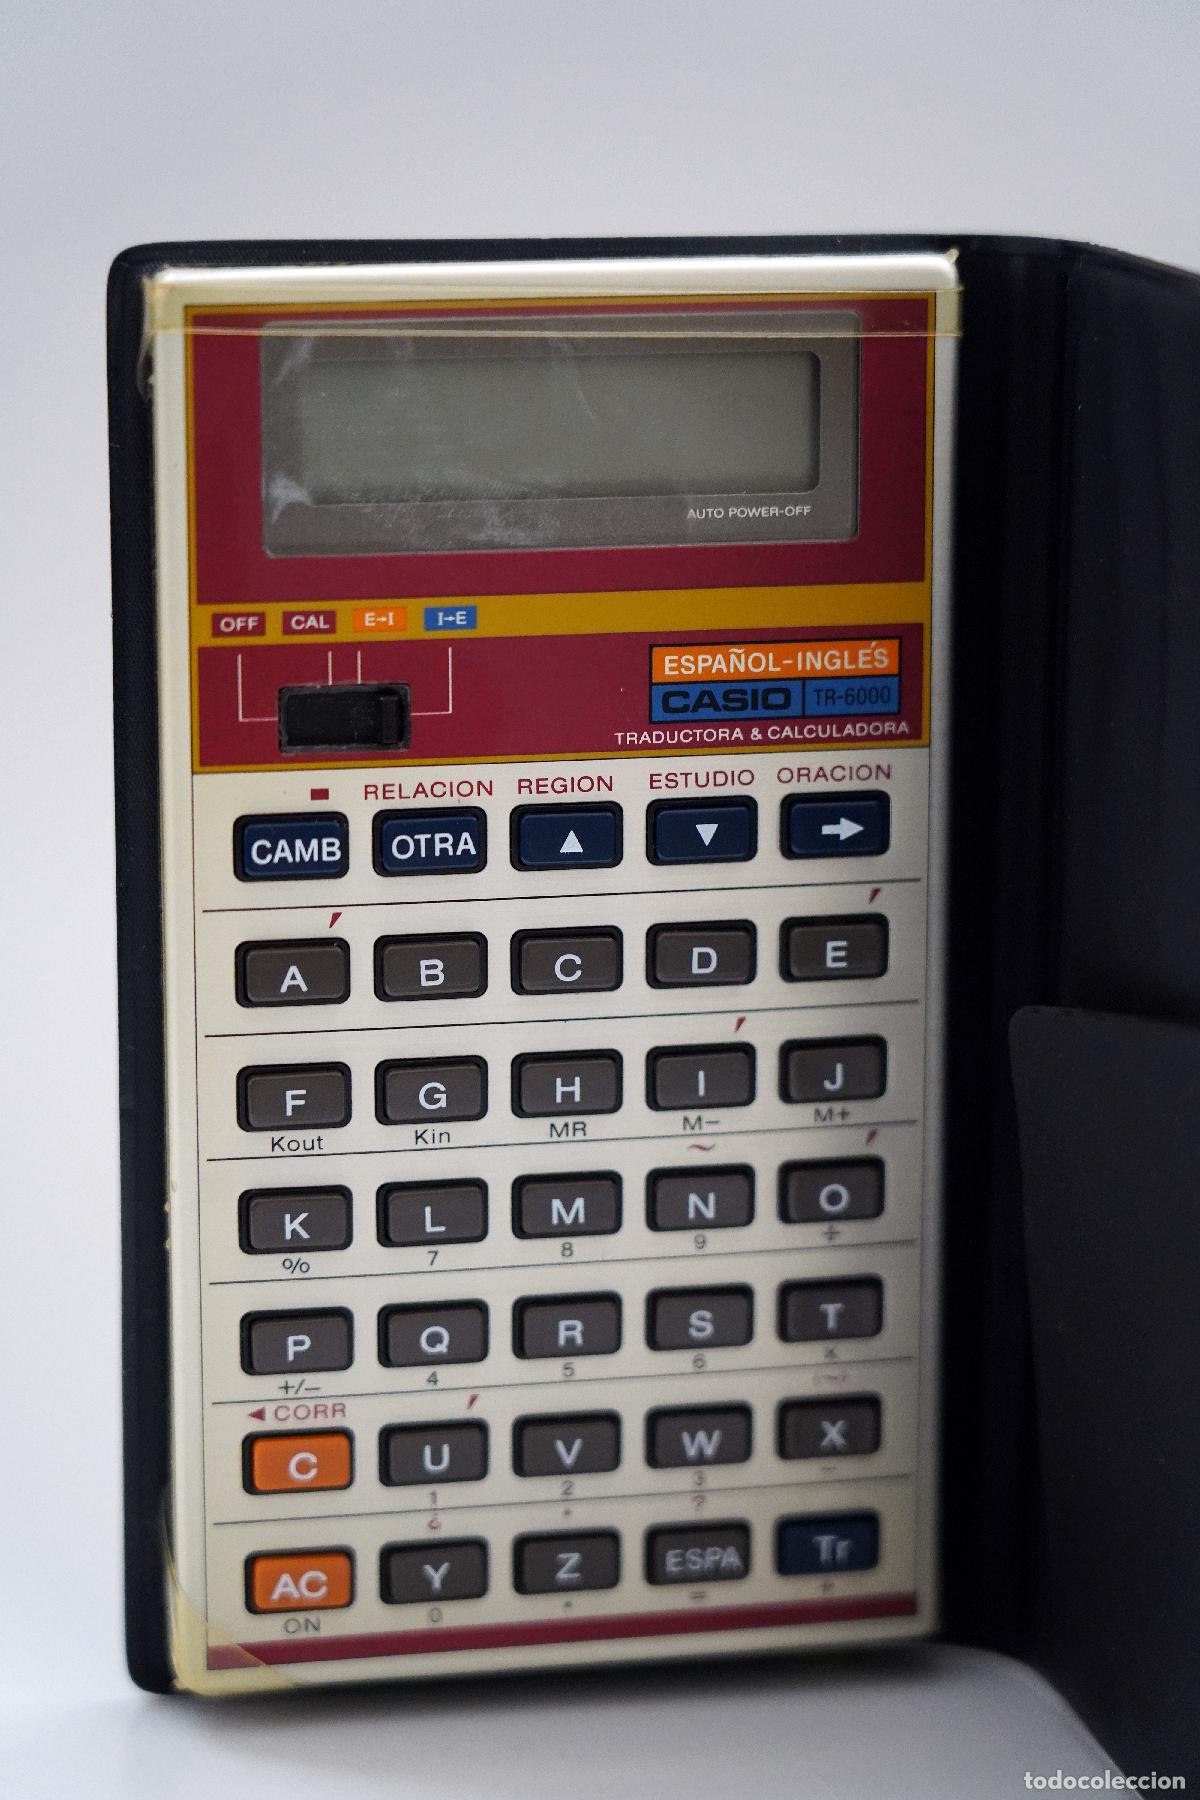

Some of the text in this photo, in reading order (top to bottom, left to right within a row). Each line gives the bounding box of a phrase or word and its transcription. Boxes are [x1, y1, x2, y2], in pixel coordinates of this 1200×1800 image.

[687, 505, 811, 519] AUTO POWER-OFF
[219, 616, 259, 633] OFF
[290, 614, 329, 630] CAL
[661, 687, 791, 714] CASIO
[813, 685, 891, 707] TR-6000
[614, 720, 910, 745] TRADUCTORA & CALCULADORA
[517, 775, 614, 795] REGION
[649, 769, 755, 789] ESTUDIO
[776, 763, 892, 784] ORACION
[364, 780, 493, 800] RELACION
[251, 837, 342, 865] CAMB
[391, 831, 477, 860] OTRA
[554, 953, 582, 982] C
[691, 947, 718, 974] D
[825, 940, 848, 968] E
[280, 965, 308, 993] A
[419, 959, 444, 987] B
[555, 1076, 581, 1103] H
[697, 1070, 705, 1097] I
[823, 1062, 844, 1091] J
[284, 1089, 307, 1116] F
[418, 1082, 447, 1109] G
[814, 1108, 850, 1123] M+
[415, 1128, 450, 1145] Kin
[549, 1121, 587, 1138] MR
[271, 1135, 324, 1152] Kout
[551, 1197, 585, 1225] M
[688, 1192, 716, 1219] N
[819, 1183, 849, 1212] O
[284, 1212, 310, 1240] K
[424, 1205, 446, 1233] L
[561, 1242, 574, 1258] 8
[694, 1235, 706, 1250] 9
[282, 1257, 310, 1274] %
[427, 1251, 439, 1266] 7
[688, 1310, 714, 1339] S
[820, 1302, 843, 1330] T
[420, 1326, 450, 1354] Q
[558, 1319, 583, 1347] R
[286, 1334, 312, 1361] P
[562, 1362, 575, 1377] 5
[693, 1354, 706, 1370] 6
[427, 1371, 439, 1386] 4
[274, 1402, 347, 1421] CORR
[681, 1429, 721, 1460] W
[820, 1420, 847, 1449] X
[288, 1452, 318, 1481] C
[424, 1443, 450, 1473] U
[555, 1438, 583, 1468] V
[430, 1491, 437, 1505] 1
[561, 1481, 574, 1496] 2
[664, 1546, 742, 1573] ESPA
[812, 1535, 853, 1563] Tr
[423, 1562, 449, 1592] Y
[555, 1552, 581, 1581] Z
[271, 1570, 329, 1600] AC
[285, 1617, 321, 1634] ON
